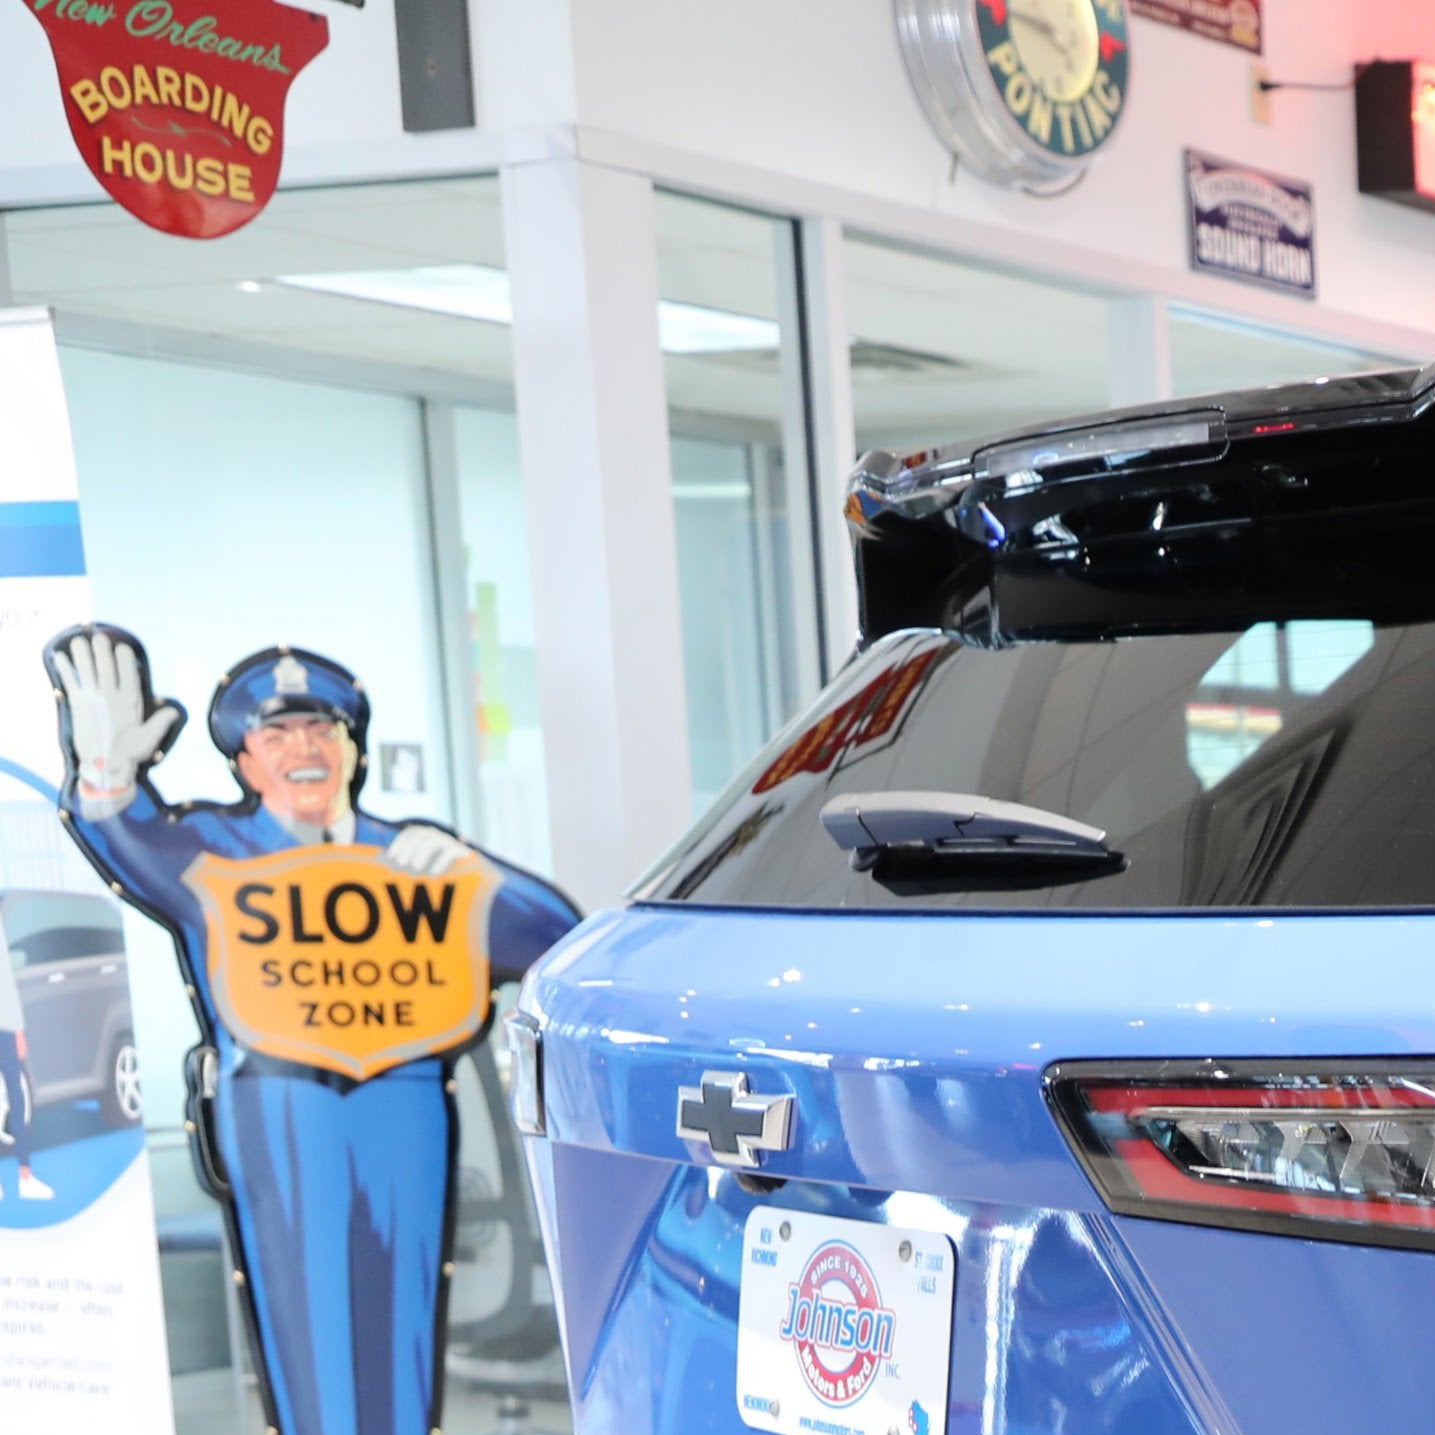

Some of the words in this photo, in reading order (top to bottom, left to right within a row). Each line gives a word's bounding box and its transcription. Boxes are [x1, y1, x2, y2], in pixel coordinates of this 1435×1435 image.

[125, 0, 290, 74] Orleans
[70, 65, 273, 155] BOARDING
[987, 40, 1121, 153] PONTIAC
[102, 136, 256, 203] HOUSE
[235, 882, 456, 945] SLOW
[261, 959, 446, 987] SCHOOL
[300, 1002, 415, 1027] ZONE
[810, 1255, 841, 1286] SINCE
[782, 1287, 894, 1354] Johnson
[801, 1344, 836, 1399] Motors
[847, 1355, 873, 1396] Ford
